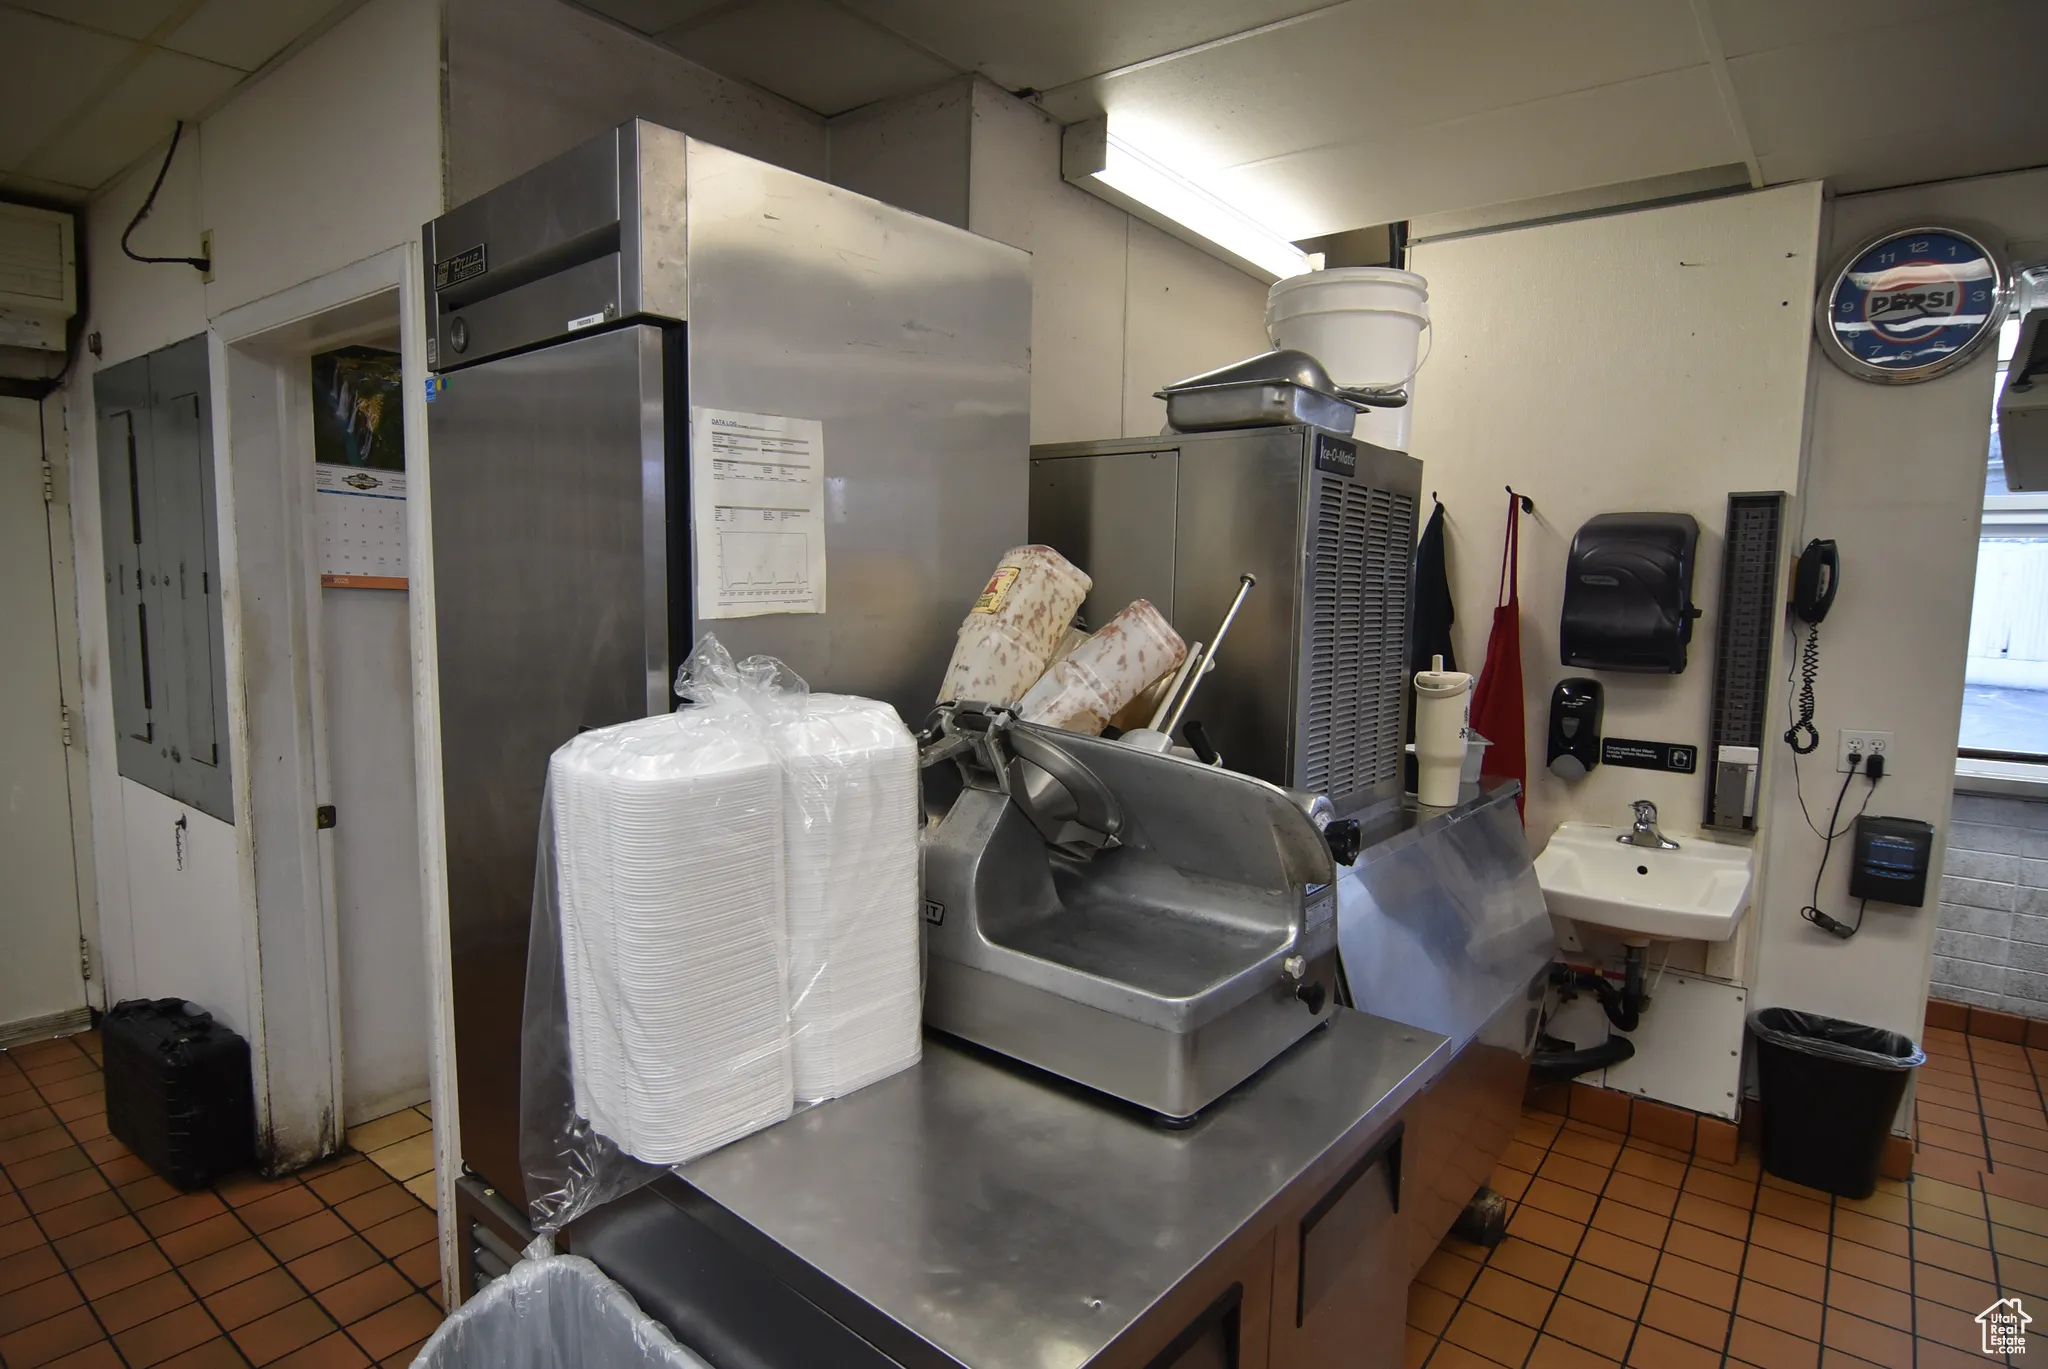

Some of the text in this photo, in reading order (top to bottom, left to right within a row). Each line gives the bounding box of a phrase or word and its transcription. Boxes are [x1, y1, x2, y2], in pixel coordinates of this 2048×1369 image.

[1908, 241, 1929, 253] 12
[1948, 246, 1956, 257] 1
[1879, 252, 1895, 264] 11
[1971, 290, 1987, 302] 3
[1841, 302, 1855, 313] 9
[1869, 345, 1883, 356] 7
[1933, 340, 1947, 351] 5
[1900, 350, 1913, 361] 6
[711, 418, 726, 426] DATA
[1320, 436, 1355, 467] Ice-O-Matic
